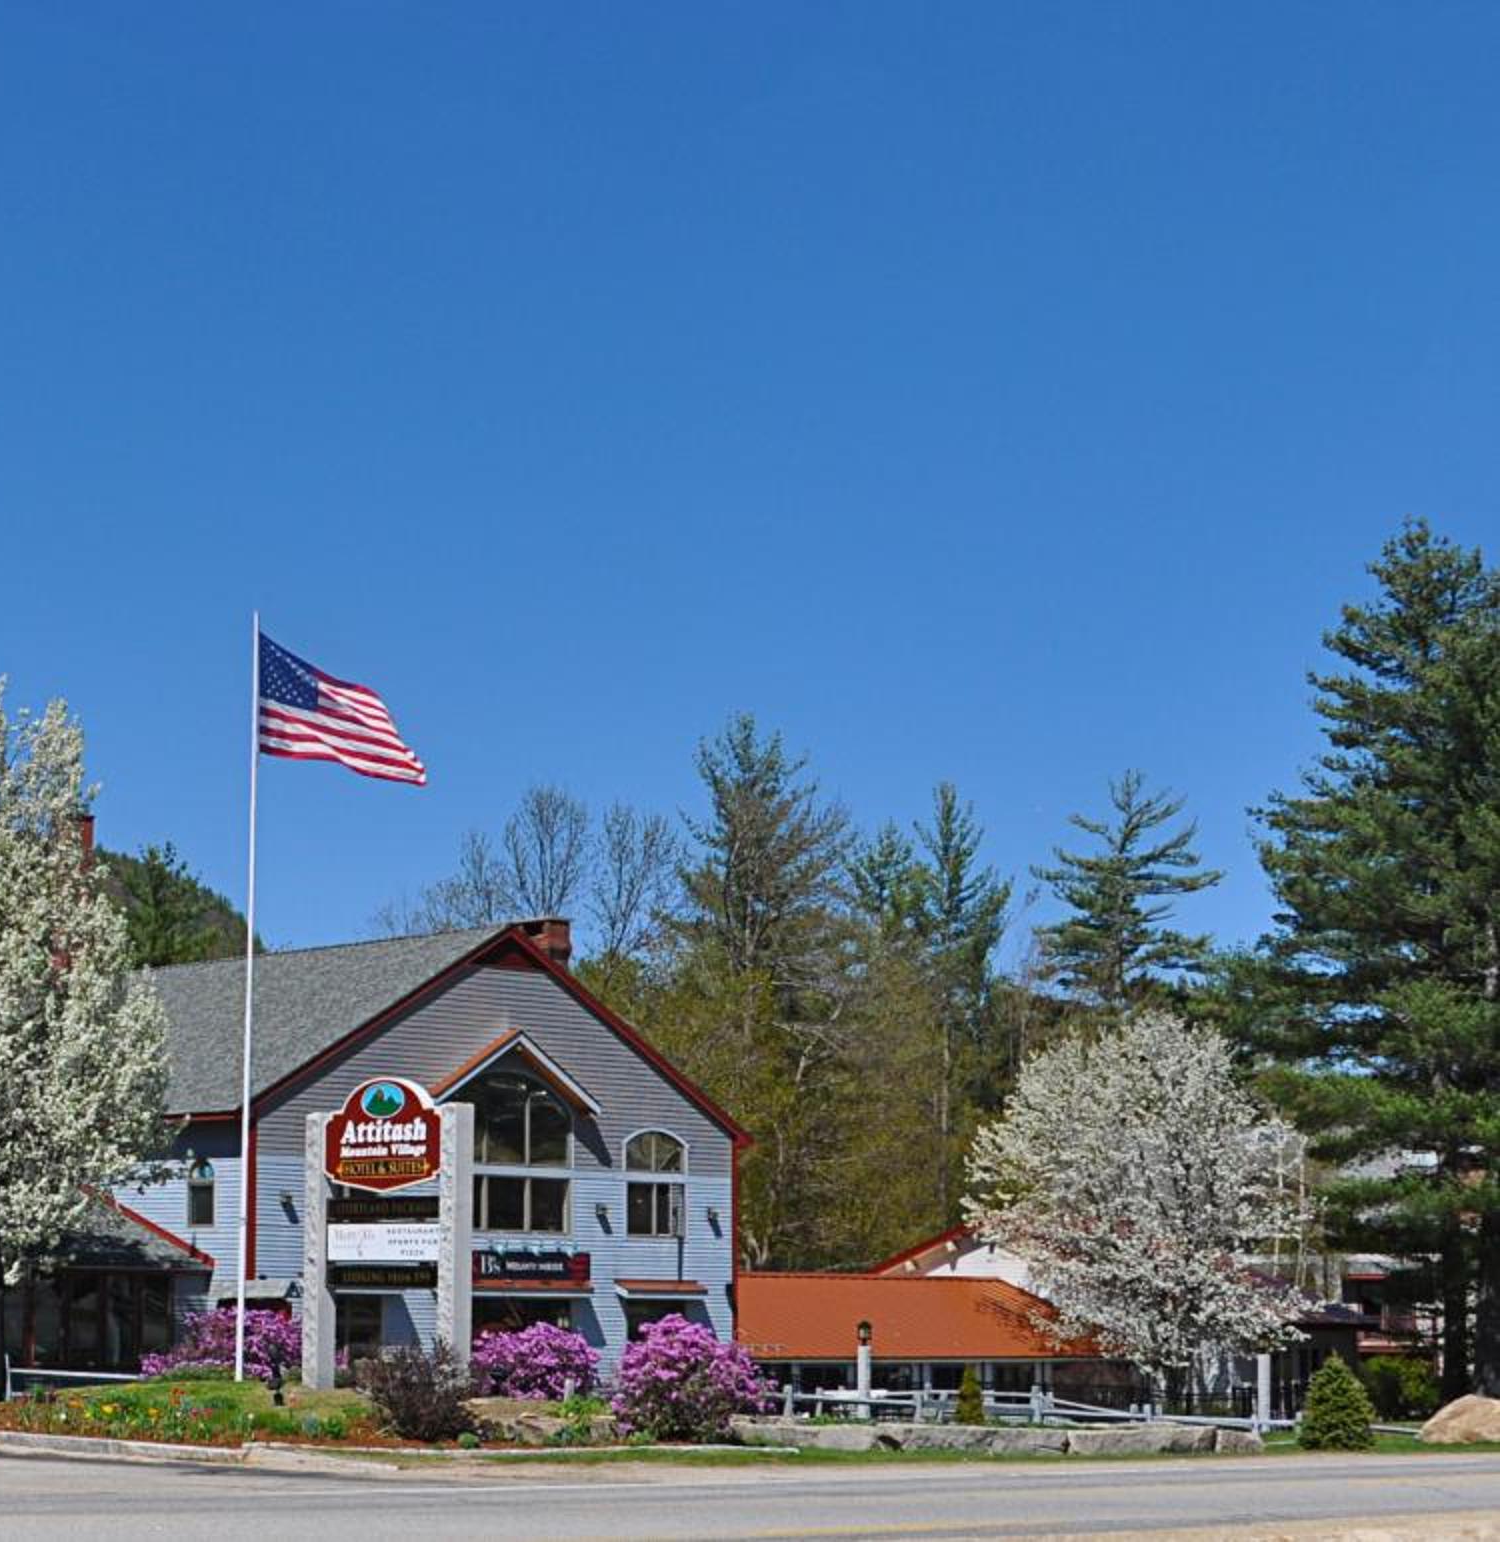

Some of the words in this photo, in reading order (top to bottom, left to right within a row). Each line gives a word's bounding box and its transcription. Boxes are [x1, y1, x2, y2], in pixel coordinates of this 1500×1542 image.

[340, 1117, 427, 1144] Attitash
[340, 1145, 388, 1158] Mountain
[390, 1144, 427, 1157] Village
[344, 1161, 376, 1175] HOTEL
[377, 1160, 385, 1173] &
[388, 1159, 422, 1173] SUITES
